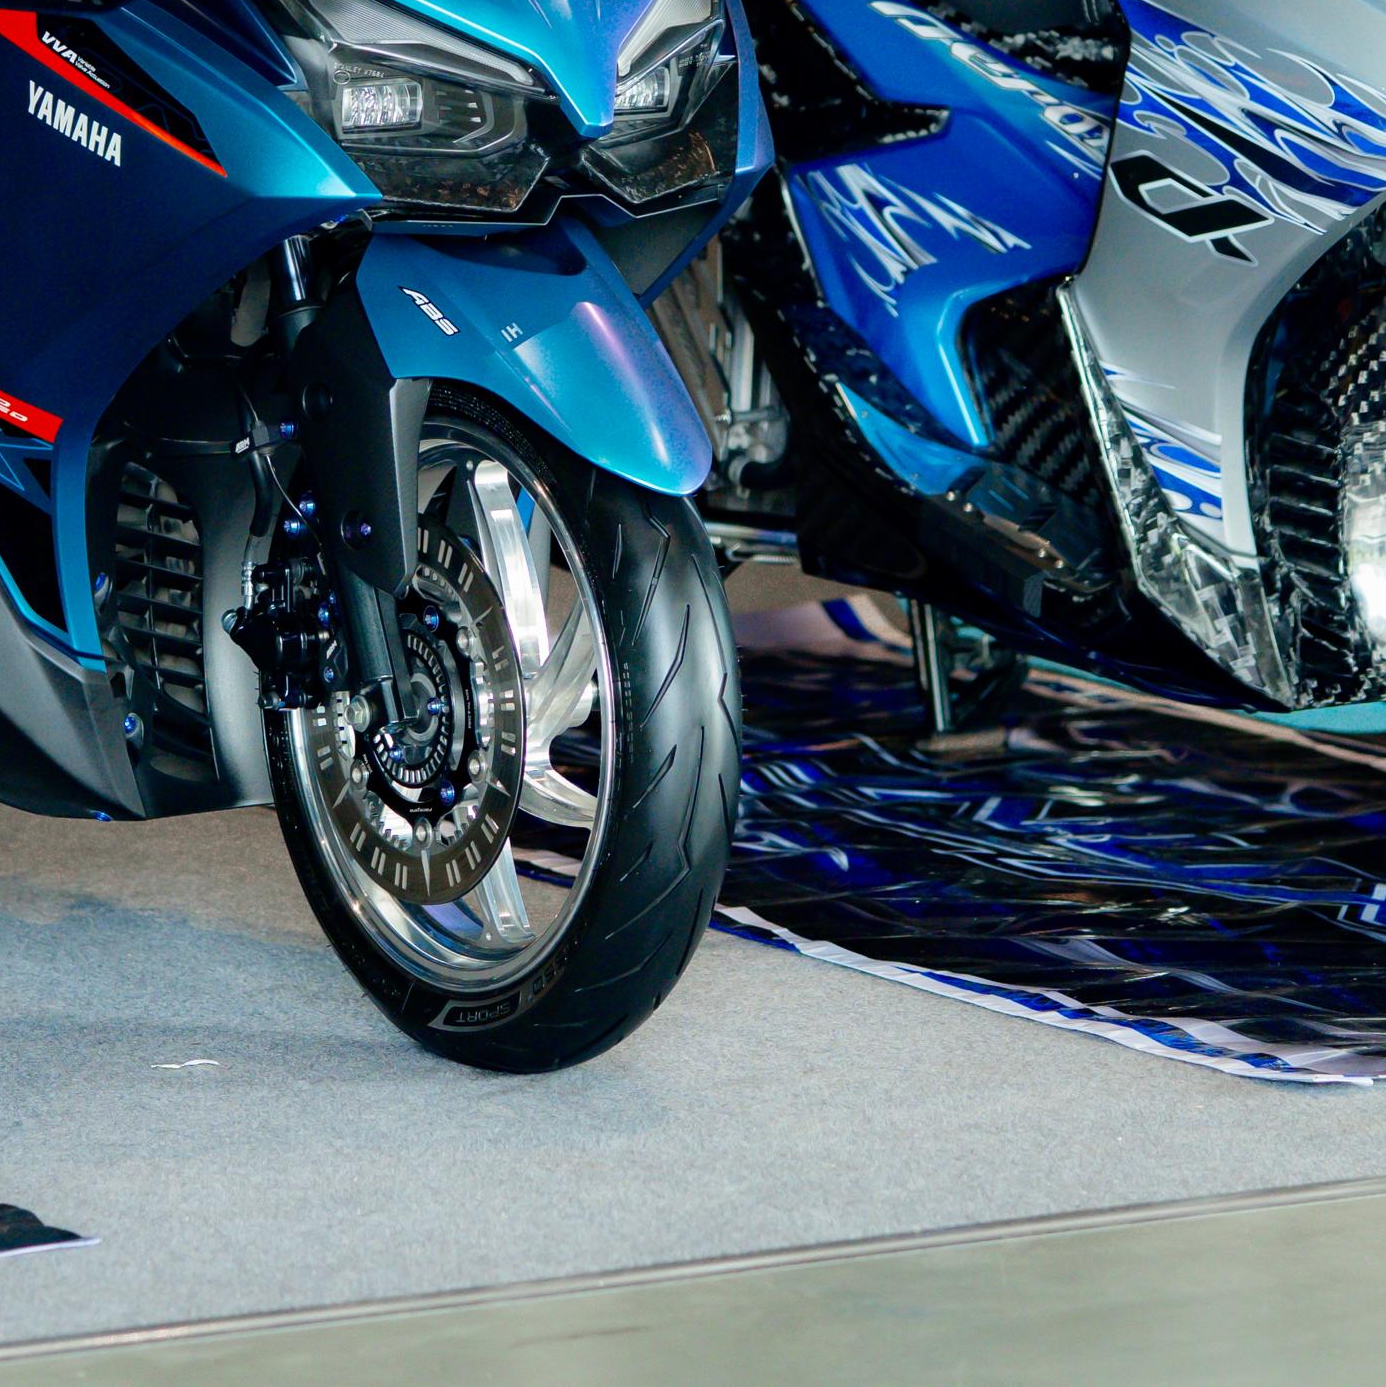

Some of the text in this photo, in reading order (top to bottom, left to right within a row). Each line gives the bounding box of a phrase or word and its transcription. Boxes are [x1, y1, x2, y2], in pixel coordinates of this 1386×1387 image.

[41, 30, 78, 64] VVA
[28, 79, 122, 167] YAMAHA
[398, 286, 460, 336] ABS
[455, 1001, 512, 1024] SPORT
